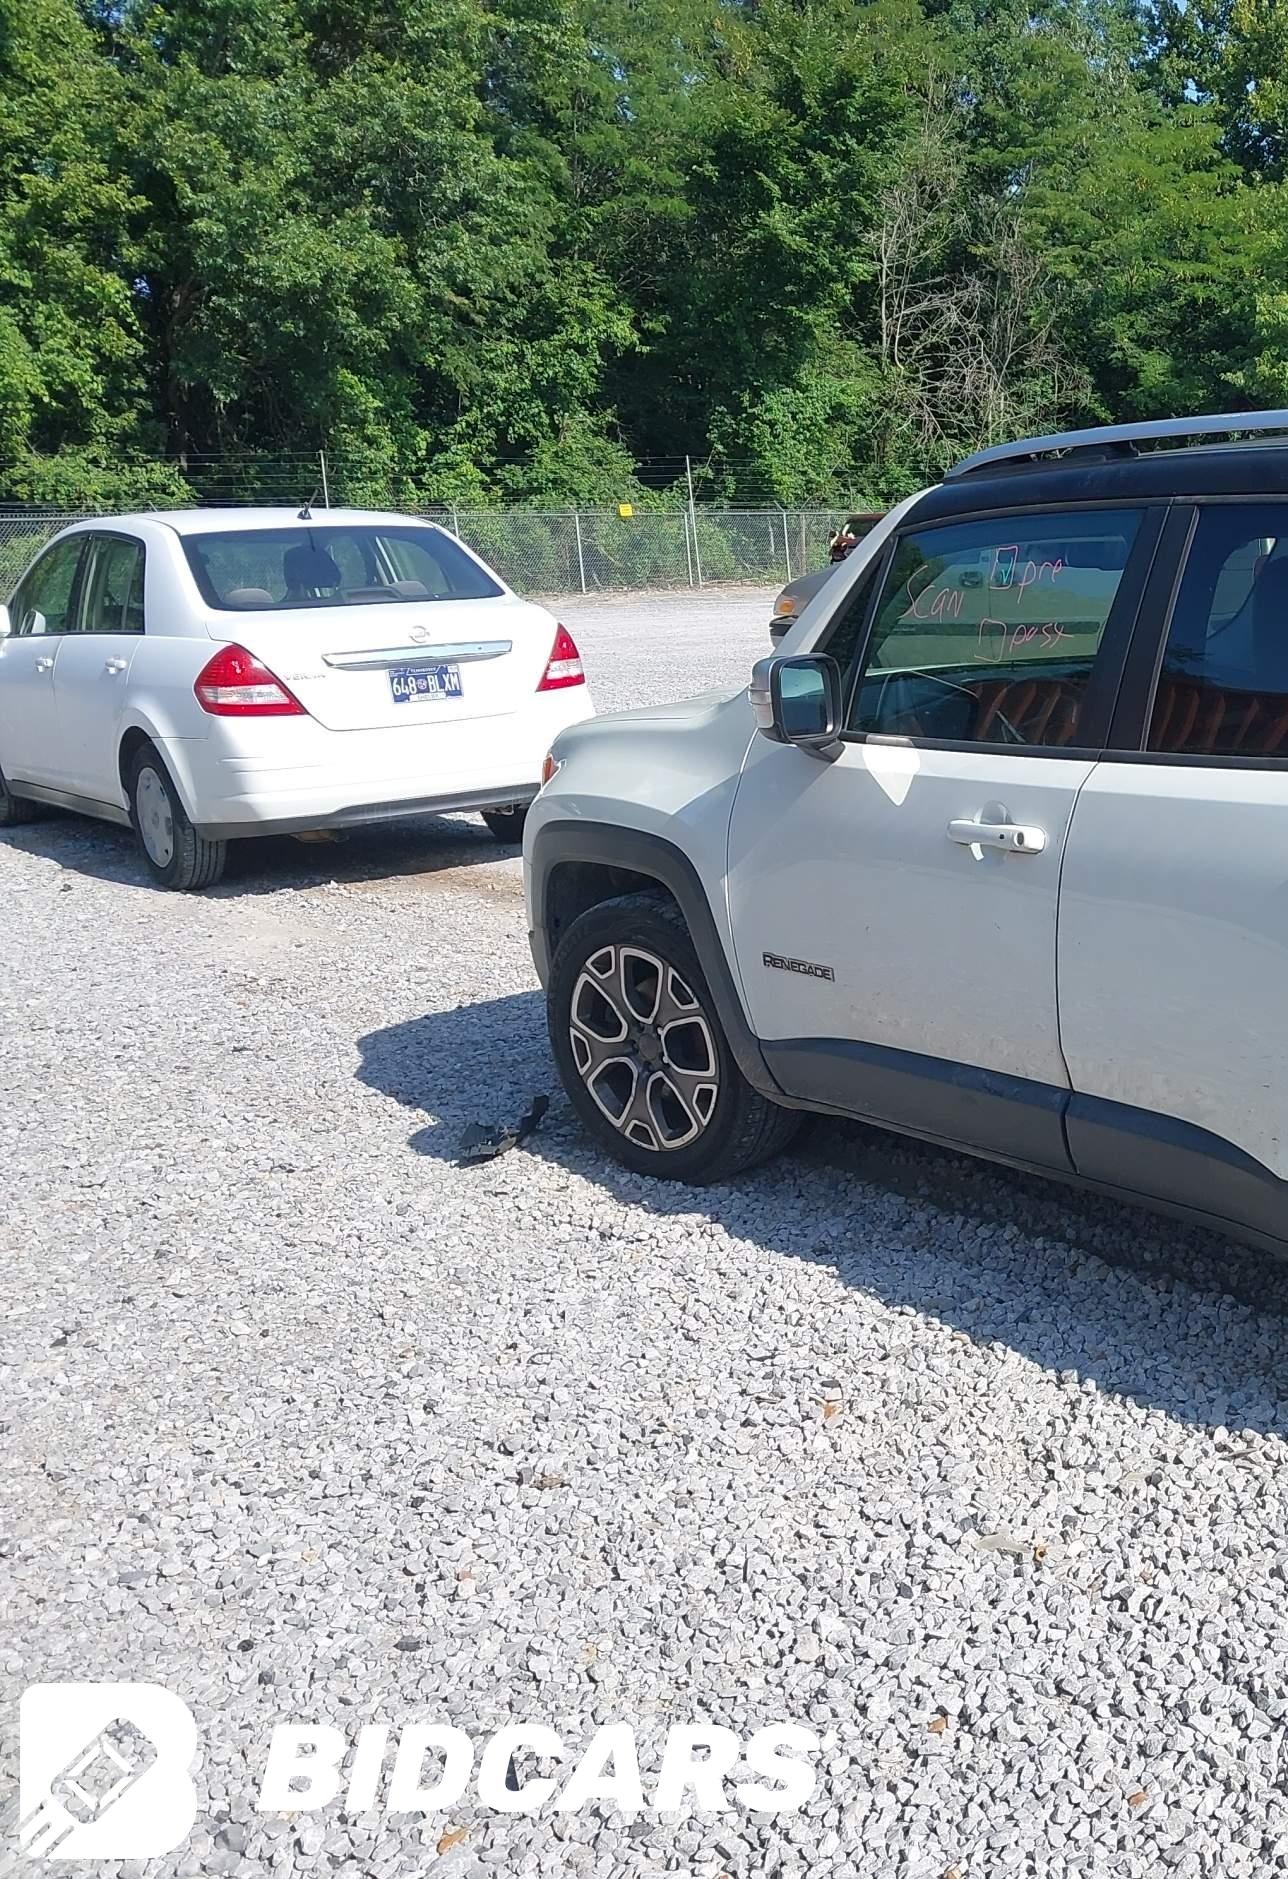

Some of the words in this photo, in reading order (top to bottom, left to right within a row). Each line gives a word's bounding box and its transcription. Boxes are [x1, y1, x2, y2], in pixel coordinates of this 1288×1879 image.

[392, 676, 417, 696] 648
[426, 673, 460, 693] BLXM
[763, 952, 834, 982] RENEGADE
